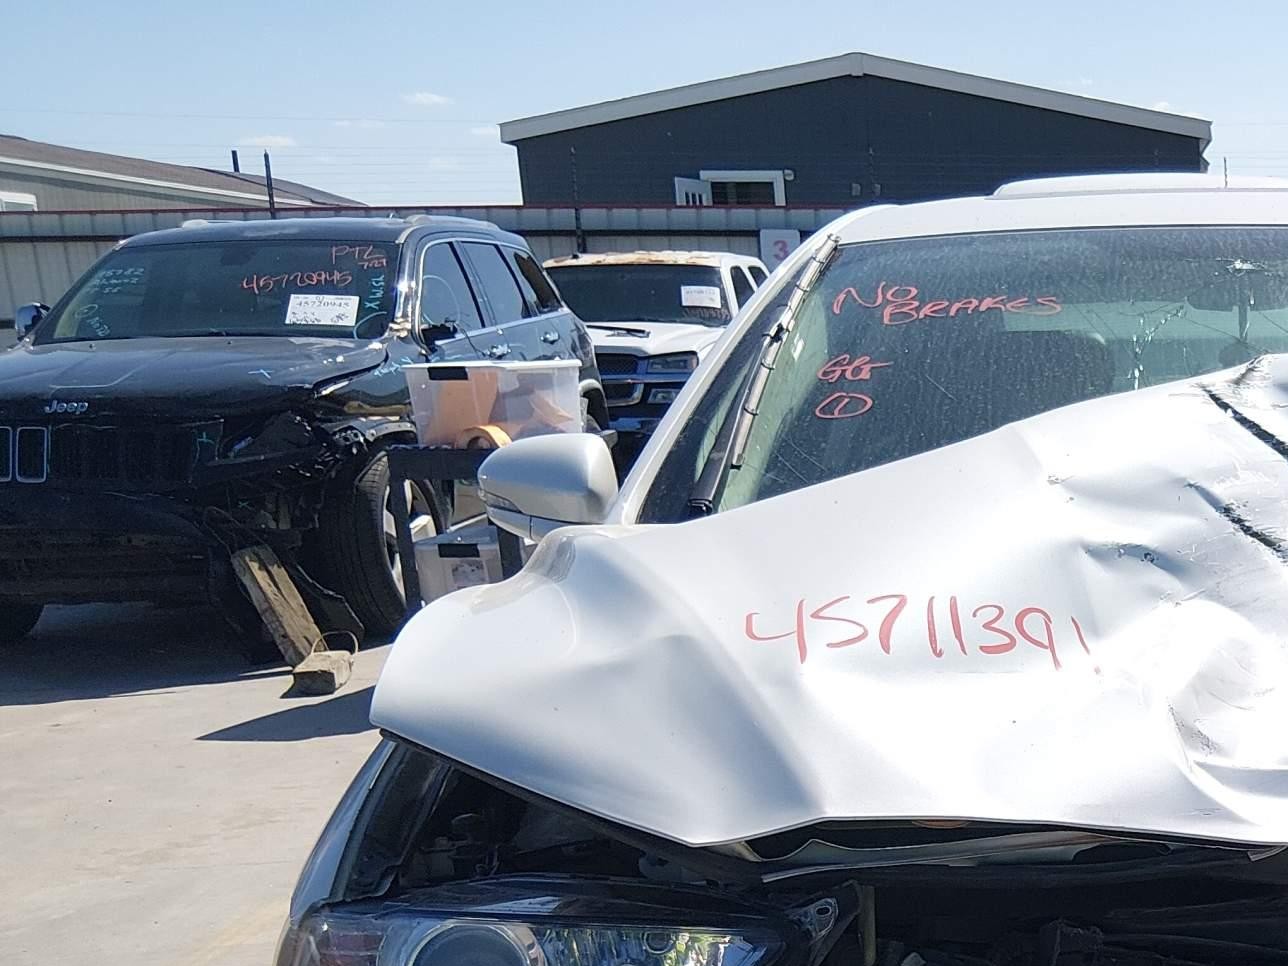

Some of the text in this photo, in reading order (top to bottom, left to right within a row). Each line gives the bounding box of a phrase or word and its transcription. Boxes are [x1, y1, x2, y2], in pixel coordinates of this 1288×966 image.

[773, 240, 790, 261] 3
[242, 269, 353, 294] 45720945
[832, 281, 918, 315] NO
[883, 296, 1062, 326] BRAKES
[44, 400, 89, 415] Jeep
[745, 594, 1091, 672] 45711391
